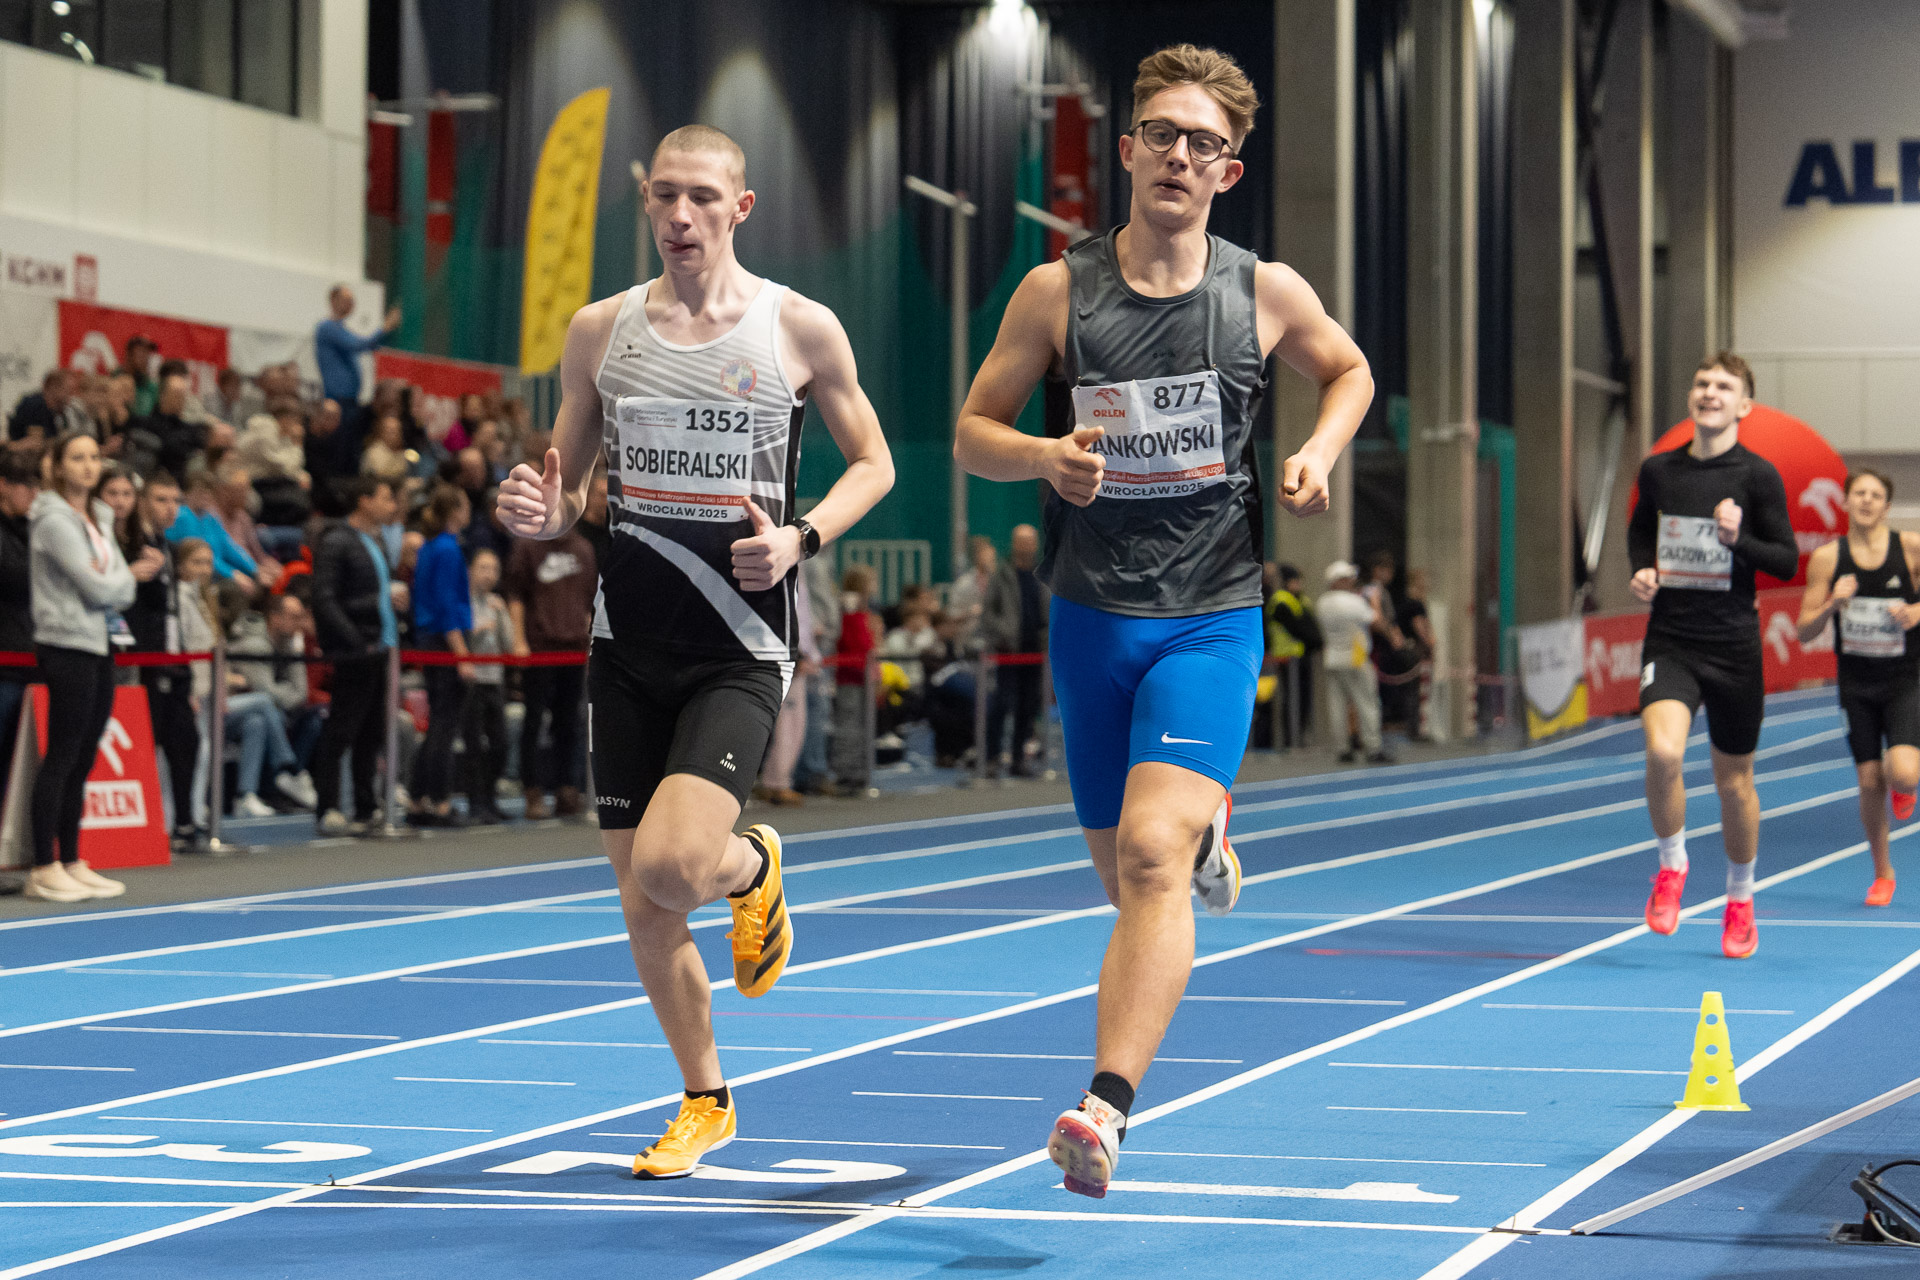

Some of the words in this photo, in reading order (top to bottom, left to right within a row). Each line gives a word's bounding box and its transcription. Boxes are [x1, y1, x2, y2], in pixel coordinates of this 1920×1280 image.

[1153, 381, 1206, 410] 877
[685, 408, 749, 433] 1352
[1093, 409, 1126, 418] ORLEN
[1088, 424, 1215, 459] ANKOWSKI
[626, 445, 747, 480] SOBIERALSKI
[1102, 484, 1170, 496] WROCŁAW
[1173, 482, 1205, 494] 2025
[637, 502, 696, 517] WROCŁAW
[699, 508, 728, 519] 2025
